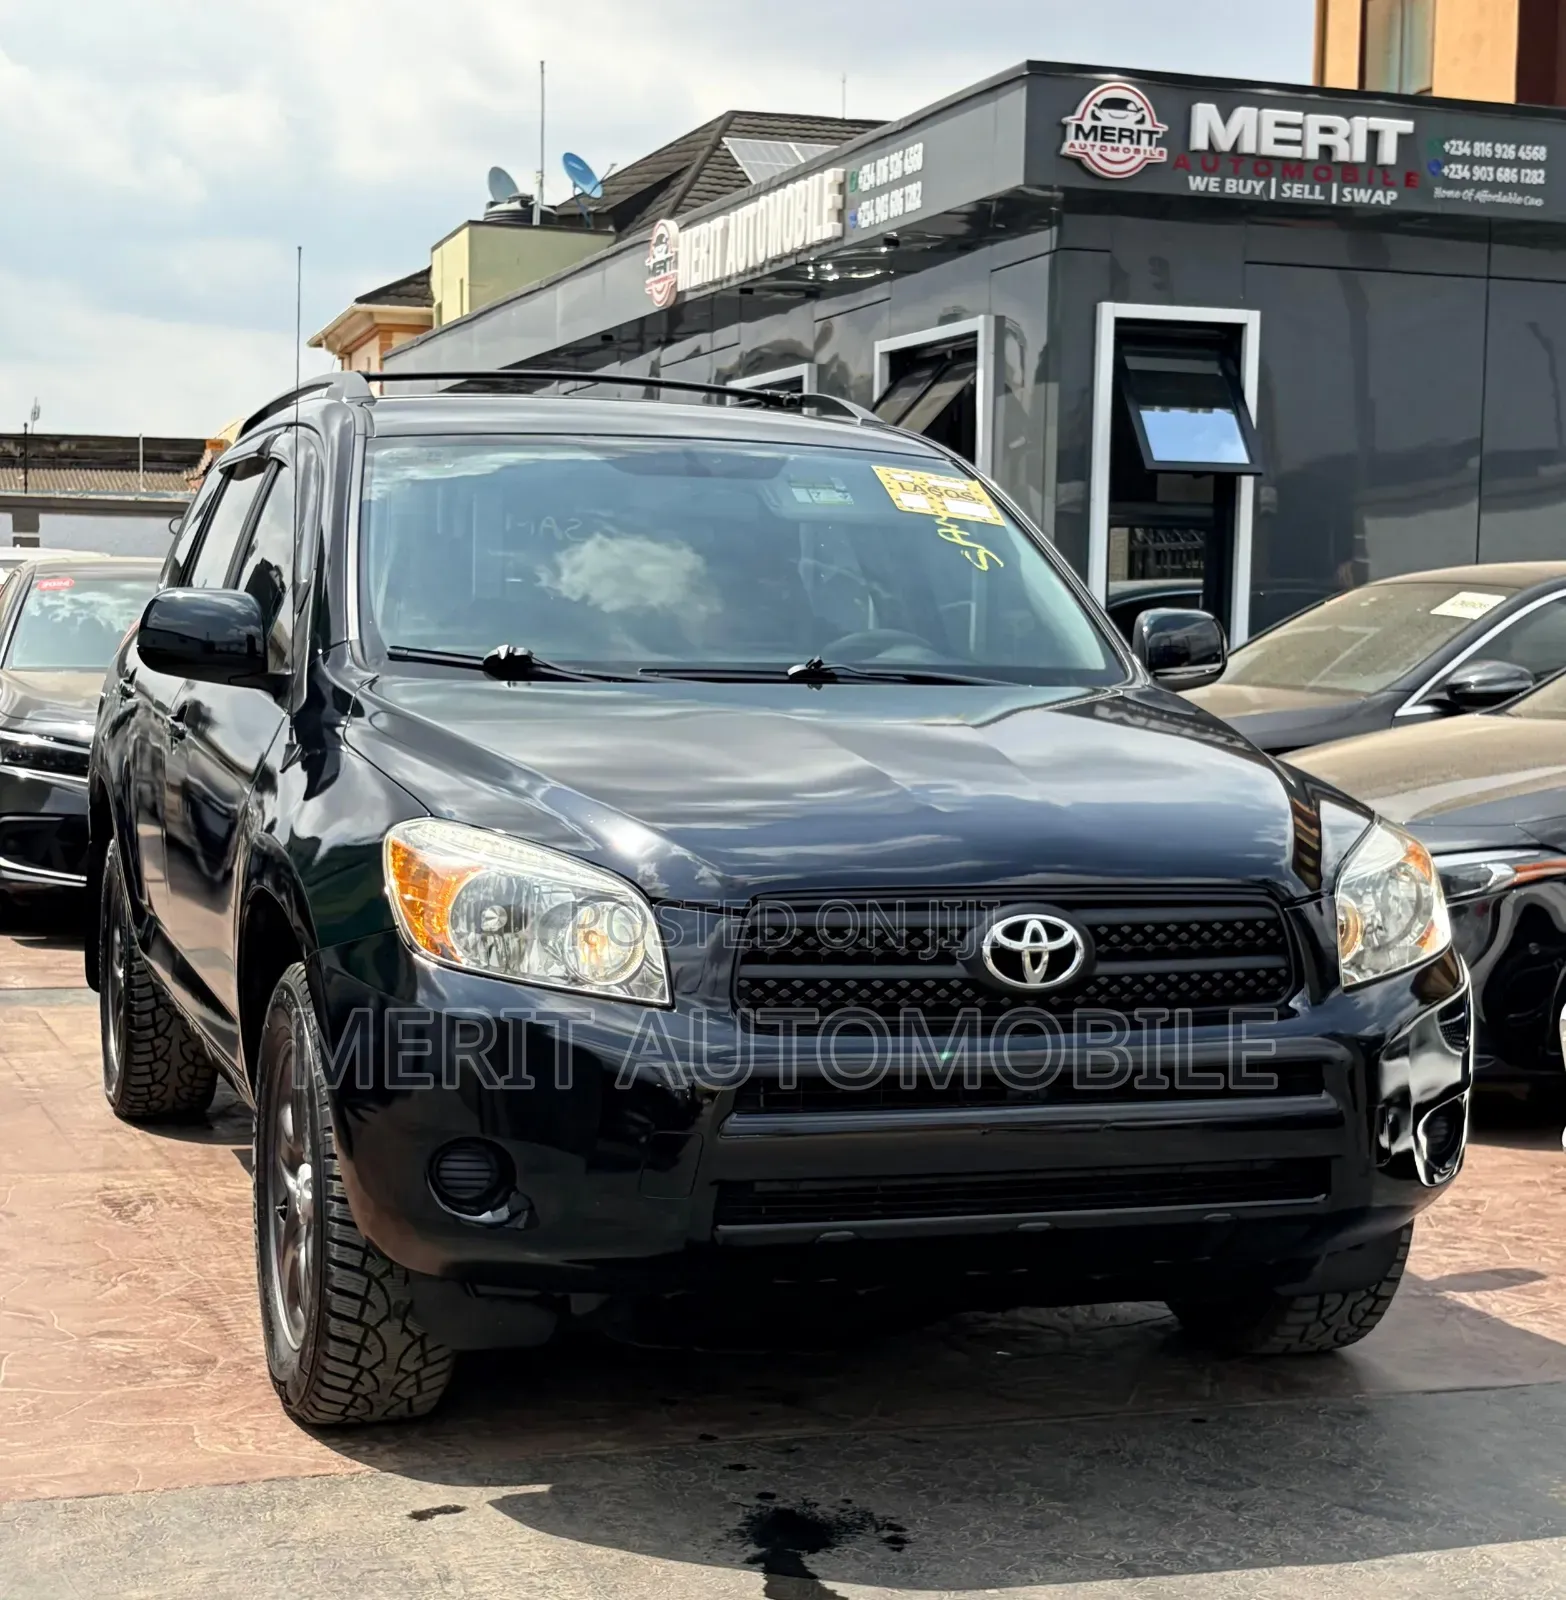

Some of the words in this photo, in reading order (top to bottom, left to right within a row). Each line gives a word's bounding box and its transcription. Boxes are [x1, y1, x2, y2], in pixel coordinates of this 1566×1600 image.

[1074, 123, 1160, 148] MERIT
[1190, 102, 1414, 165] MERIT
[1068, 142, 1165, 157] AUTOMOBILE
[1443, 139, 1471, 156] +234
[1472, 141, 1493, 158] 816
[1494, 143, 1516, 160] 926
[1517, 144, 1547, 161] 4568
[1172, 153, 1421, 189] AUTOMOBILE
[1442, 163, 1471, 180] +234
[1472, 165, 1494, 181] 903
[1496, 167, 1518, 183] 686
[1520, 168, 1545, 184] 1282
[1187, 175, 1222, 192] WE
[1224, 177, 1266, 196] BUY
[1281, 182, 1325, 200] SELL
[1341, 186, 1398, 206] SWAP
[677, 215, 730, 291] MERIT
[725, 168, 846, 271] AUTOMOBILE
[898, 481, 977, 502] LAGOS
